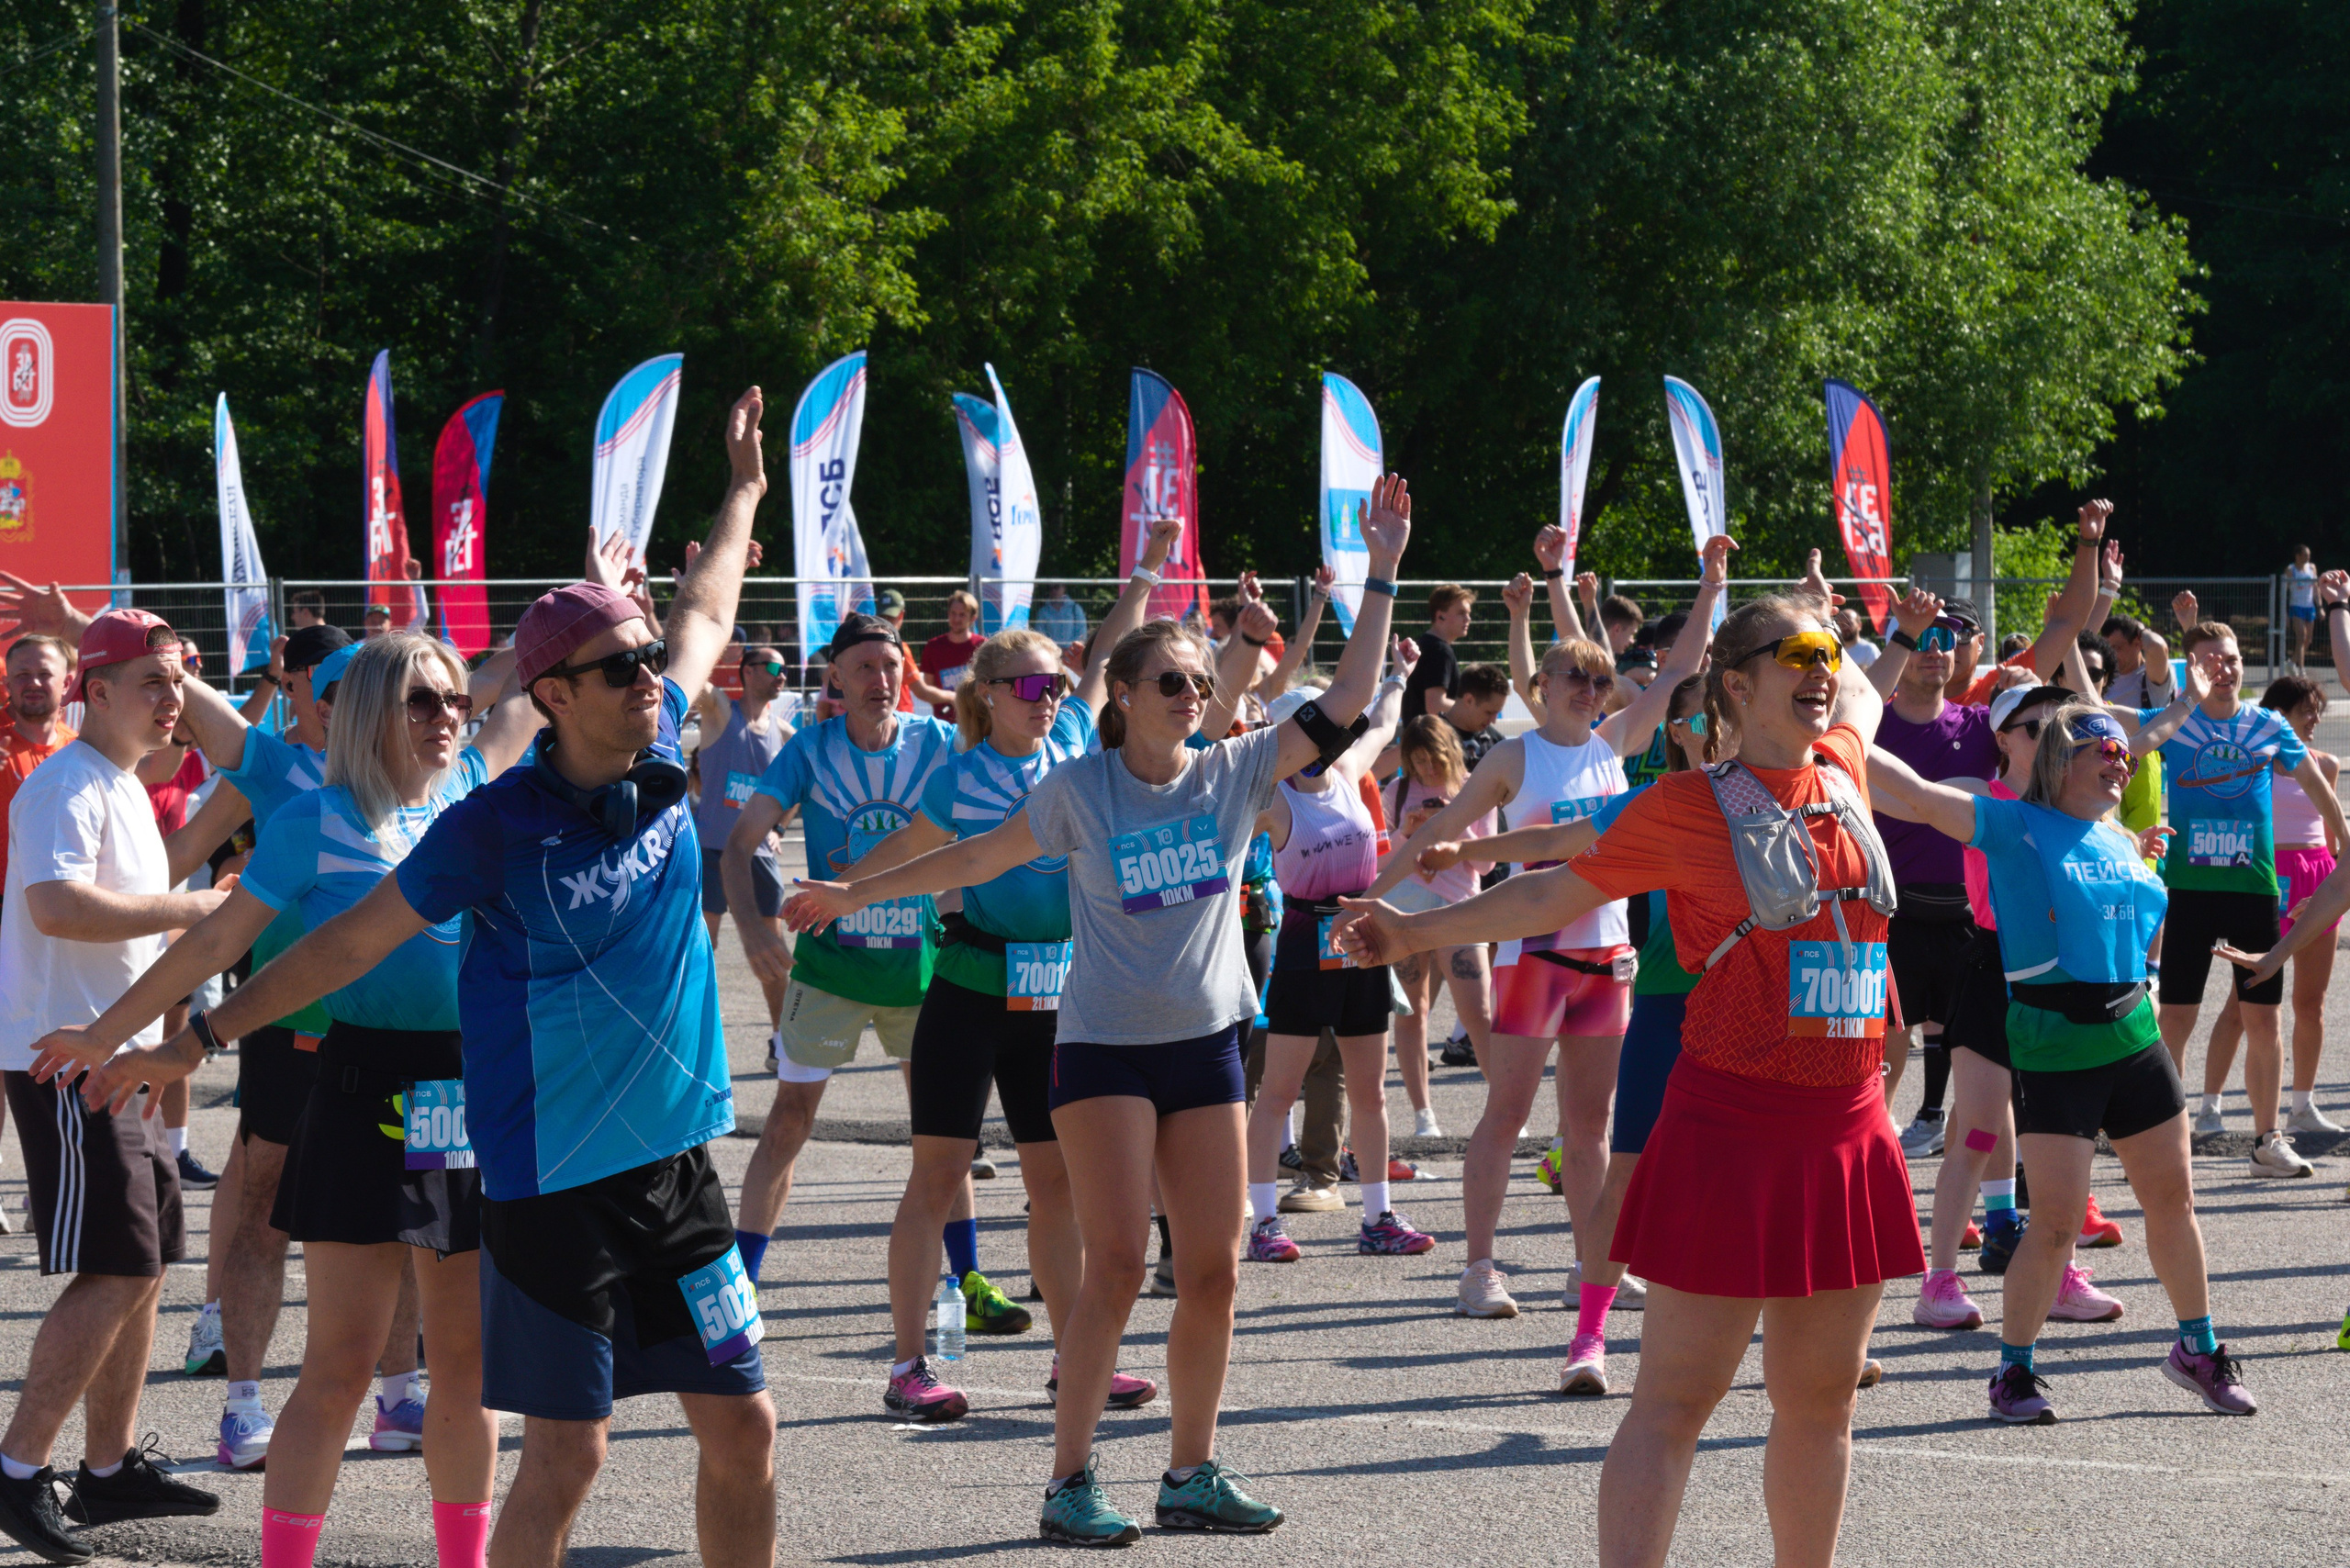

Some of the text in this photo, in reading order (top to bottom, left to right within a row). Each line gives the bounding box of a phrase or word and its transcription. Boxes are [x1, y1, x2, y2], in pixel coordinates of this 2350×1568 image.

[81, 649, 108, 661] Panasonic
[730, 780, 757, 801] 700
[1121, 828, 1174, 850] ПСБ 10
[1335, 834, 1352, 846] WE
[2193, 832, 2248, 855] 50104
[1119, 839, 1219, 894] 50025
[2064, 857, 2154, 883] ПЕЙСЕР
[2209, 856, 2231, 867] 10KM
[1158, 884, 1195, 906] 10KM
[841, 906, 917, 935] 50029
[865, 935, 893, 949] 10KM
[1045, 946, 1058, 959] 10
[1801, 968, 1882, 1014] 70001
[1032, 996, 1059, 1011] 21.1KM
[1826, 1016, 1865, 1038] 21.1KM
[444, 1149, 476, 1170] 10KM
[694, 1251, 742, 1290] ПСБ 10
[272, 1514, 320, 1529] cep
